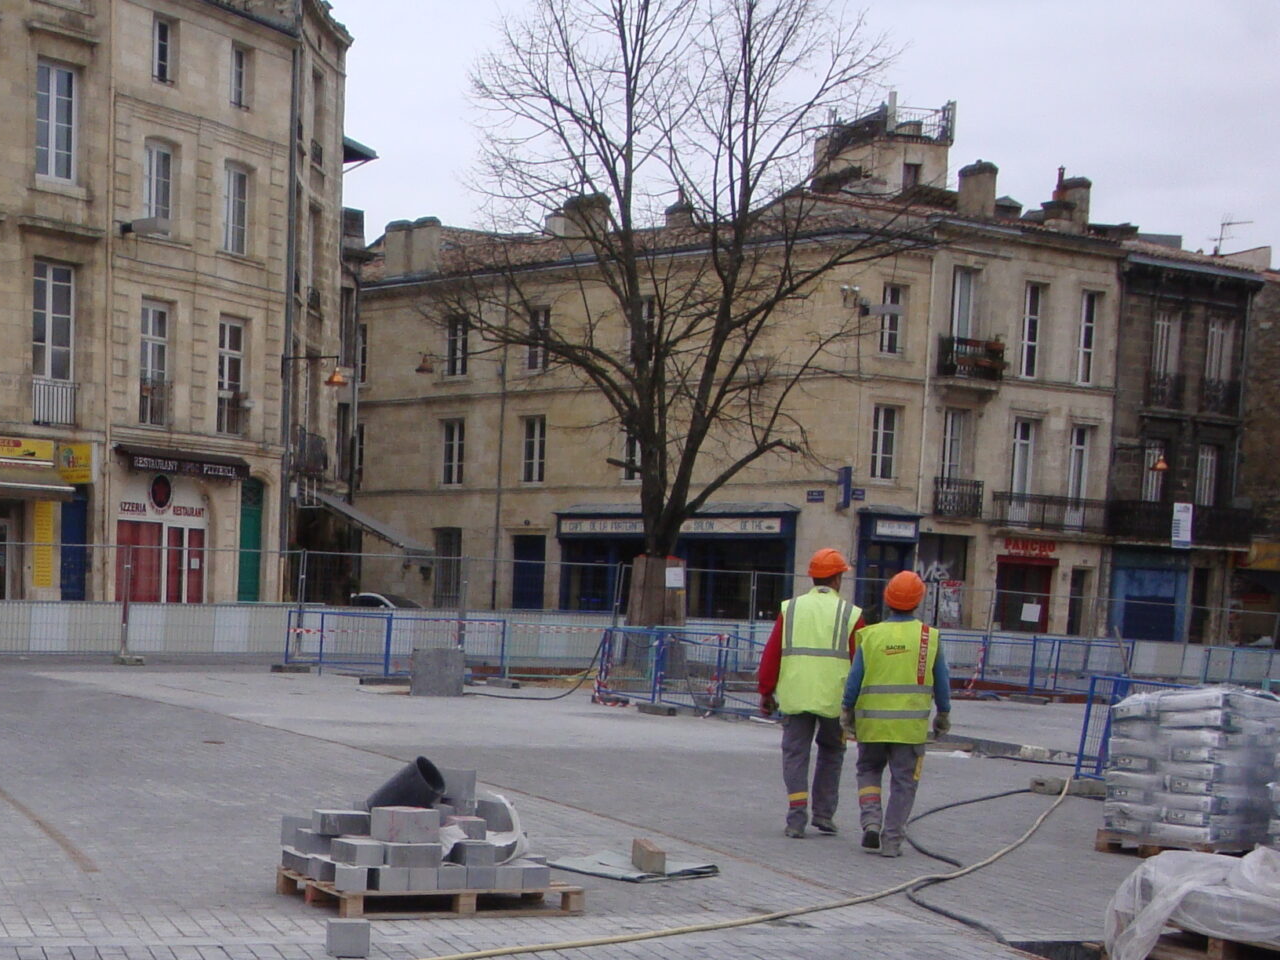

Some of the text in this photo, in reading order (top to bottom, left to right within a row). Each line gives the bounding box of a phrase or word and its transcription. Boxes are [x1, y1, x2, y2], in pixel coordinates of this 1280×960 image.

[134, 457, 178, 470] RESTAURANT
[203, 464, 236, 476] PIZZERIA
[120, 501, 147, 513] IZZERIA
[172, 505, 205, 518] RESTAURANT
